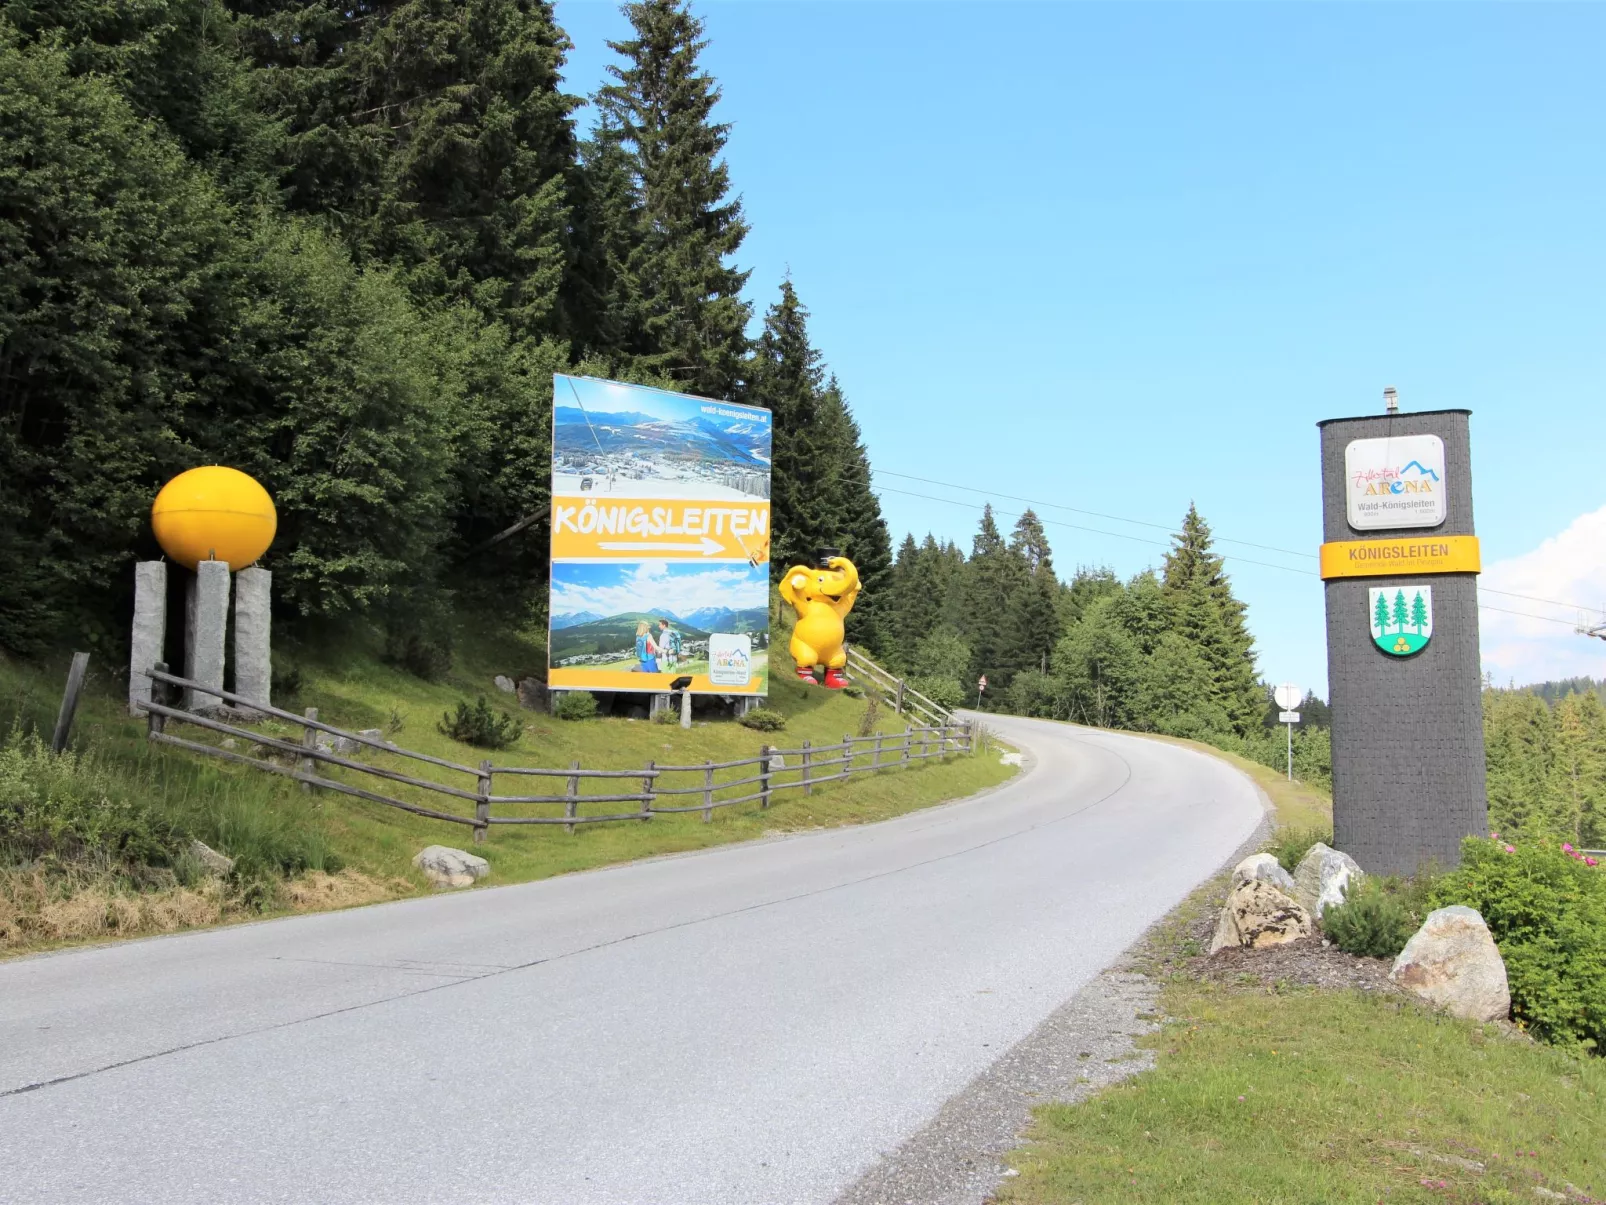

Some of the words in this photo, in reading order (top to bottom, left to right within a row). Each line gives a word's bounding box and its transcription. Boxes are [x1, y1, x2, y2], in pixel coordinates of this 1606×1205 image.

[701, 405, 767, 423] wald-koenigsleiten.at
[1357, 500, 1435, 512] Wald-Königsleiten
[554, 498, 768, 538] KÖNIGSLEITEN
[1349, 544, 1449, 560] KÖNIGSLEITEN
